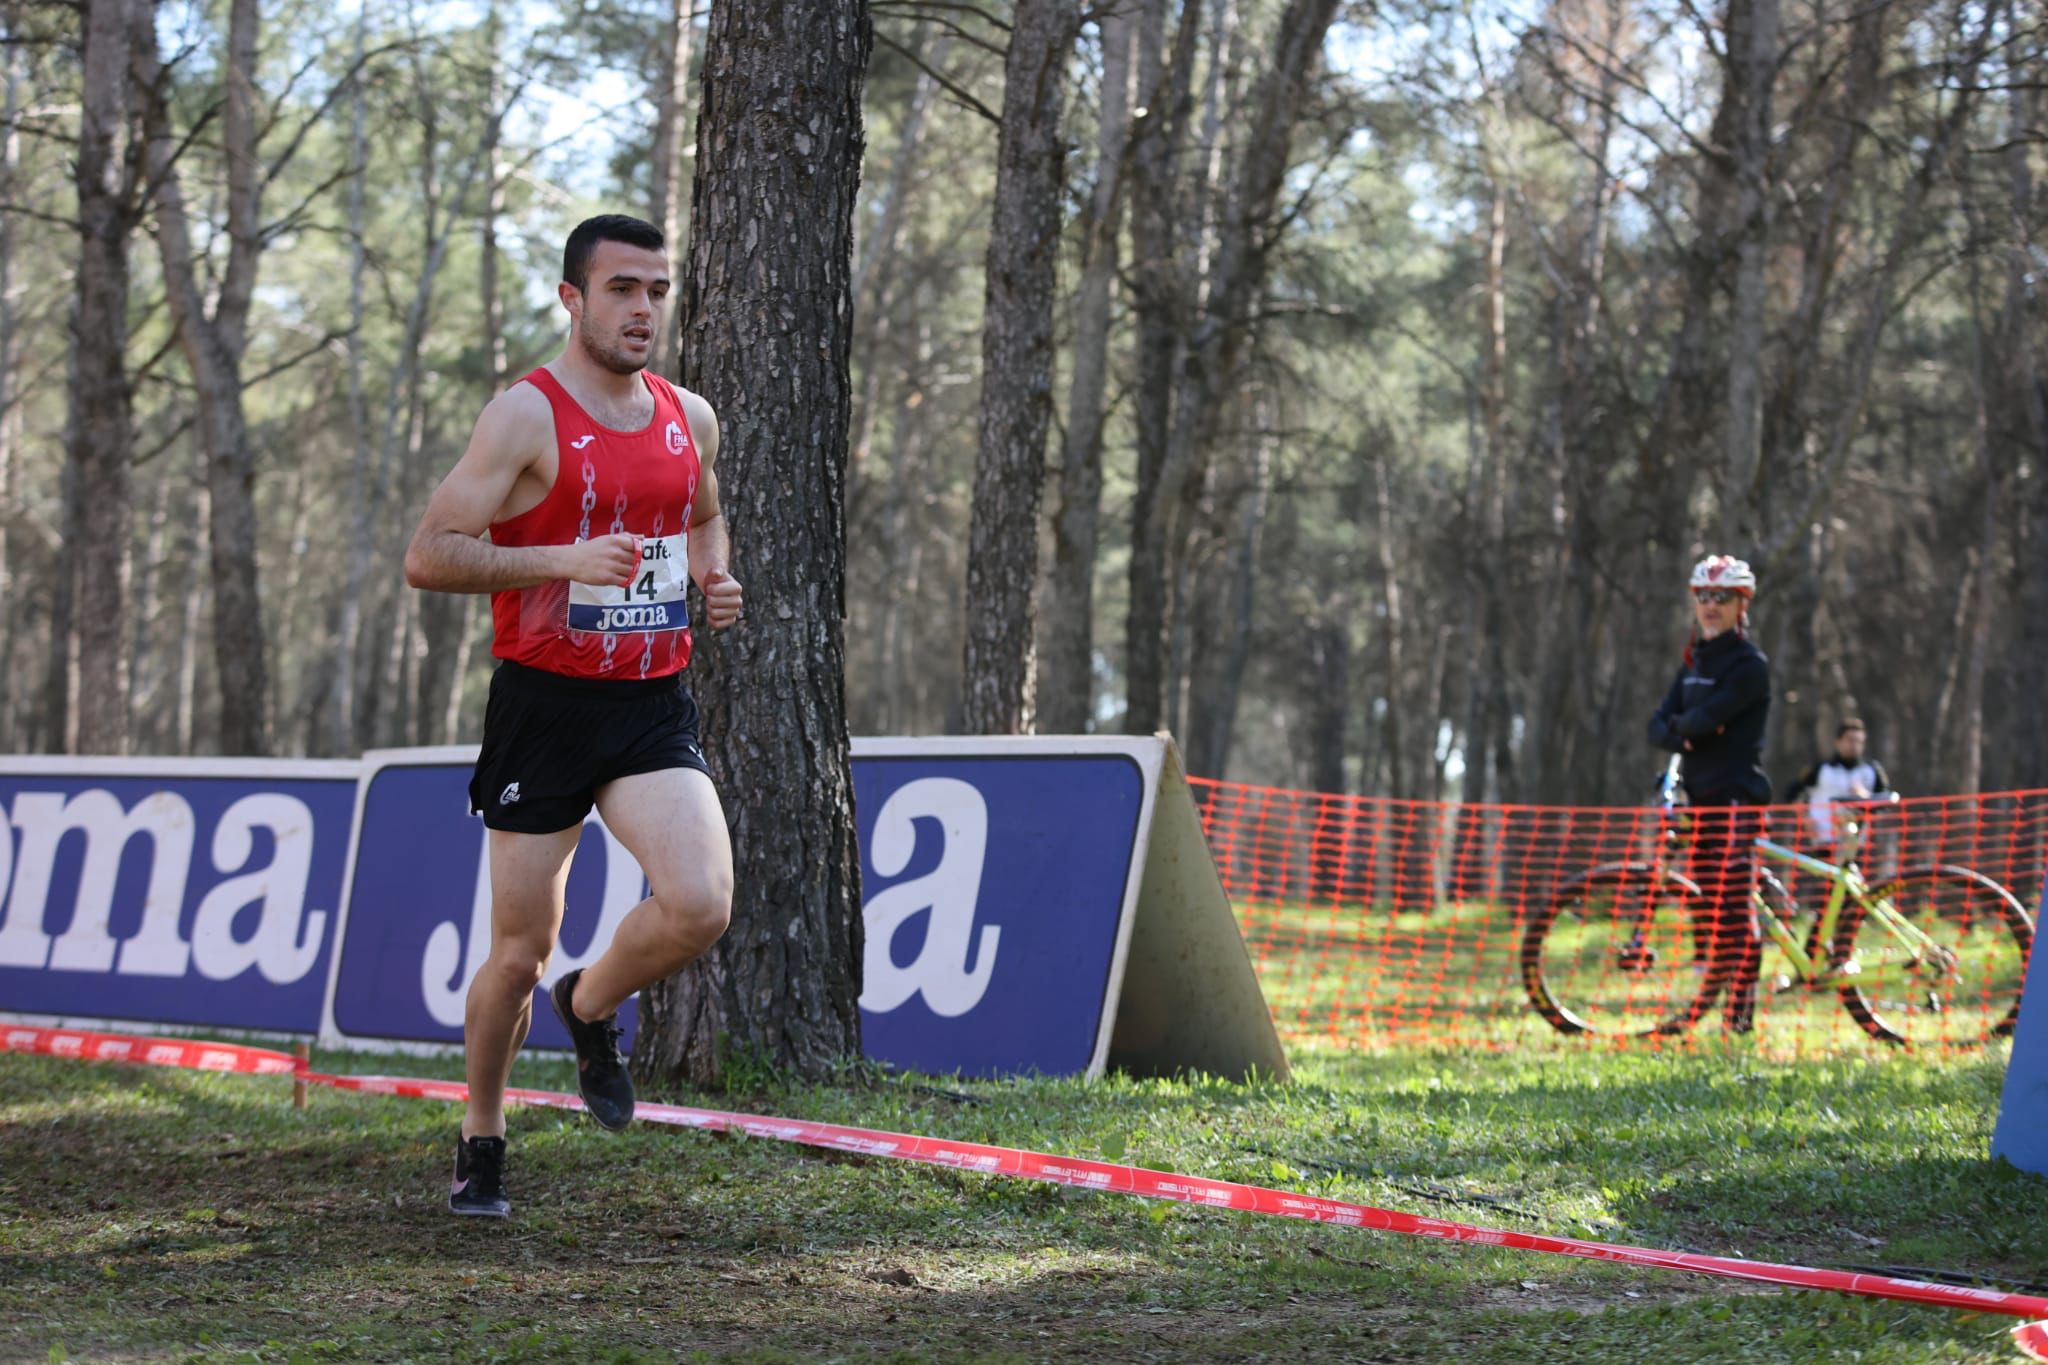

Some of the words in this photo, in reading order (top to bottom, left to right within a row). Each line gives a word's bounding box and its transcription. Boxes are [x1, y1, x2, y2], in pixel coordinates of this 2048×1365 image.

[596, 605, 669, 631] Joma
[0, 789, 327, 985] ma
[421, 777, 1001, 1028] Joa
